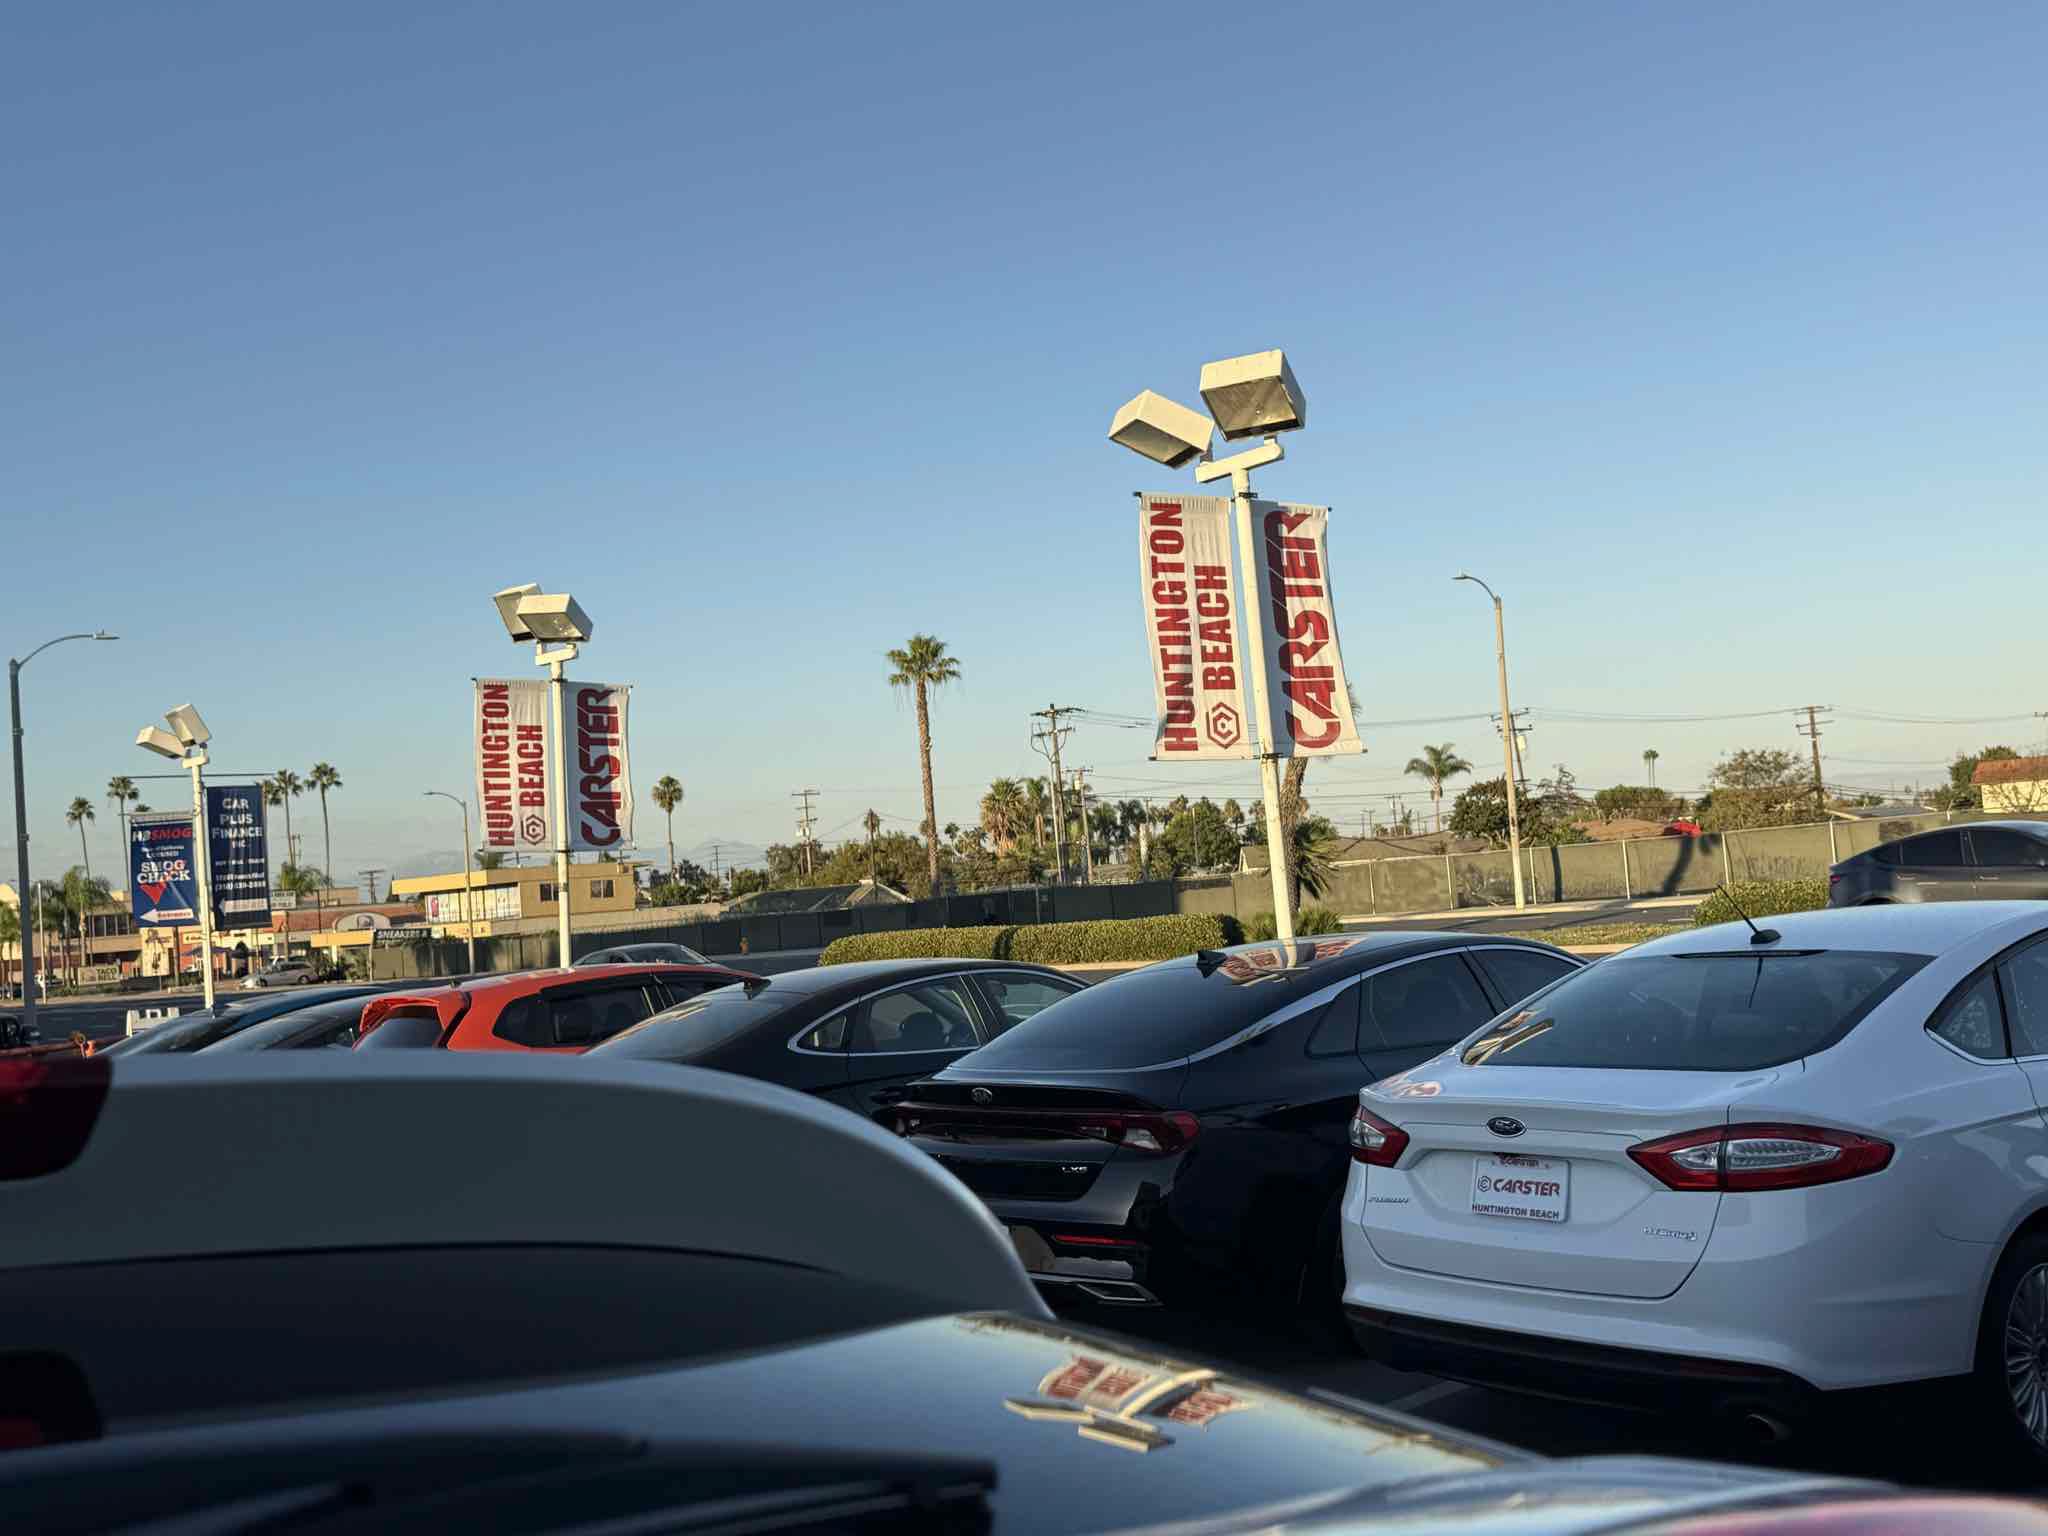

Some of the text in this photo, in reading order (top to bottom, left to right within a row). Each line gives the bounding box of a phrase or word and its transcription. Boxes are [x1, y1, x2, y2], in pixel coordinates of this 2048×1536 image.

[1150, 502, 1199, 751] HUNTINGTON
[1194, 565, 1237, 690] BEACH
[1263, 510, 1341, 749] CARSTER
[481, 684, 515, 846] HUNTINGTON
[516, 725, 545, 806] BEACH
[576, 688, 621, 846] CARSTER
[220, 814, 253, 825] PLUS
[222, 798, 249, 809] CAR
[212, 827, 263, 839] FINANCE
[141, 860, 186, 873] SMOG
[1472, 1203, 1559, 1219] HUNTINGTON BEACH
[1493, 1179, 1560, 1197] CARSTER
